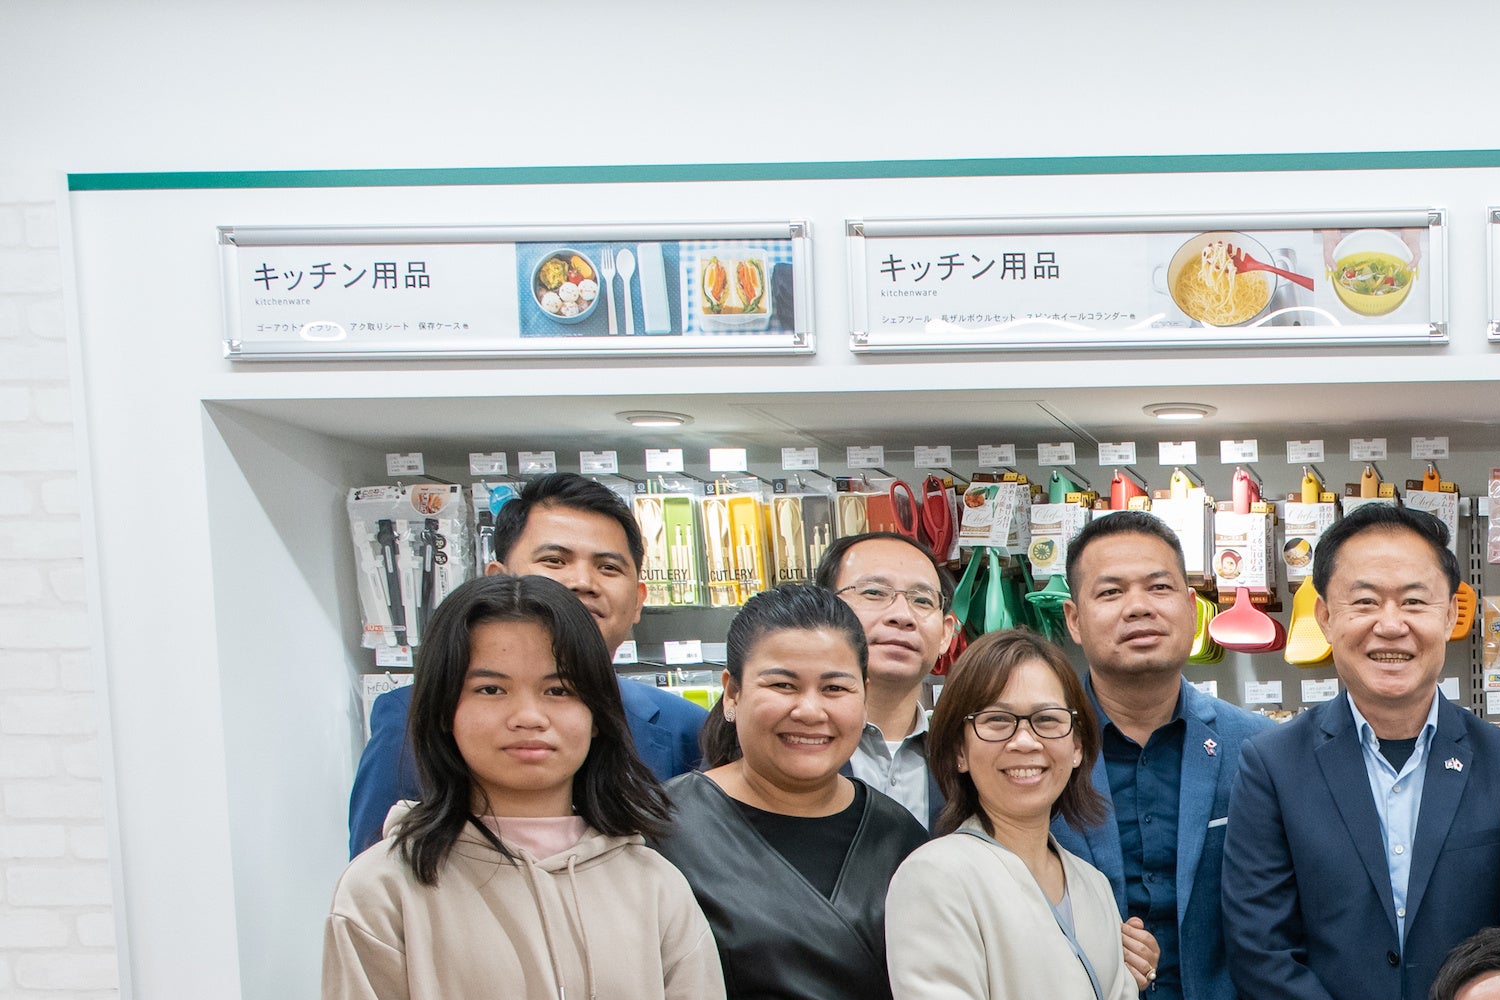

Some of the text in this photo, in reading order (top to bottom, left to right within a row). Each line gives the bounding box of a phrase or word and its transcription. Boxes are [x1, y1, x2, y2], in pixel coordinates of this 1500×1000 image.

[880, 251, 1060, 282] キッチン用品
[254, 261, 431, 291] キッチン用品
[881, 289, 938, 297] kitchenware
[255, 298, 311, 306] kitchenware
[350, 322, 409, 331] アク取りシート
[641, 568, 688, 581] CUTLERY
[710, 568, 754, 581] CUTLERY
